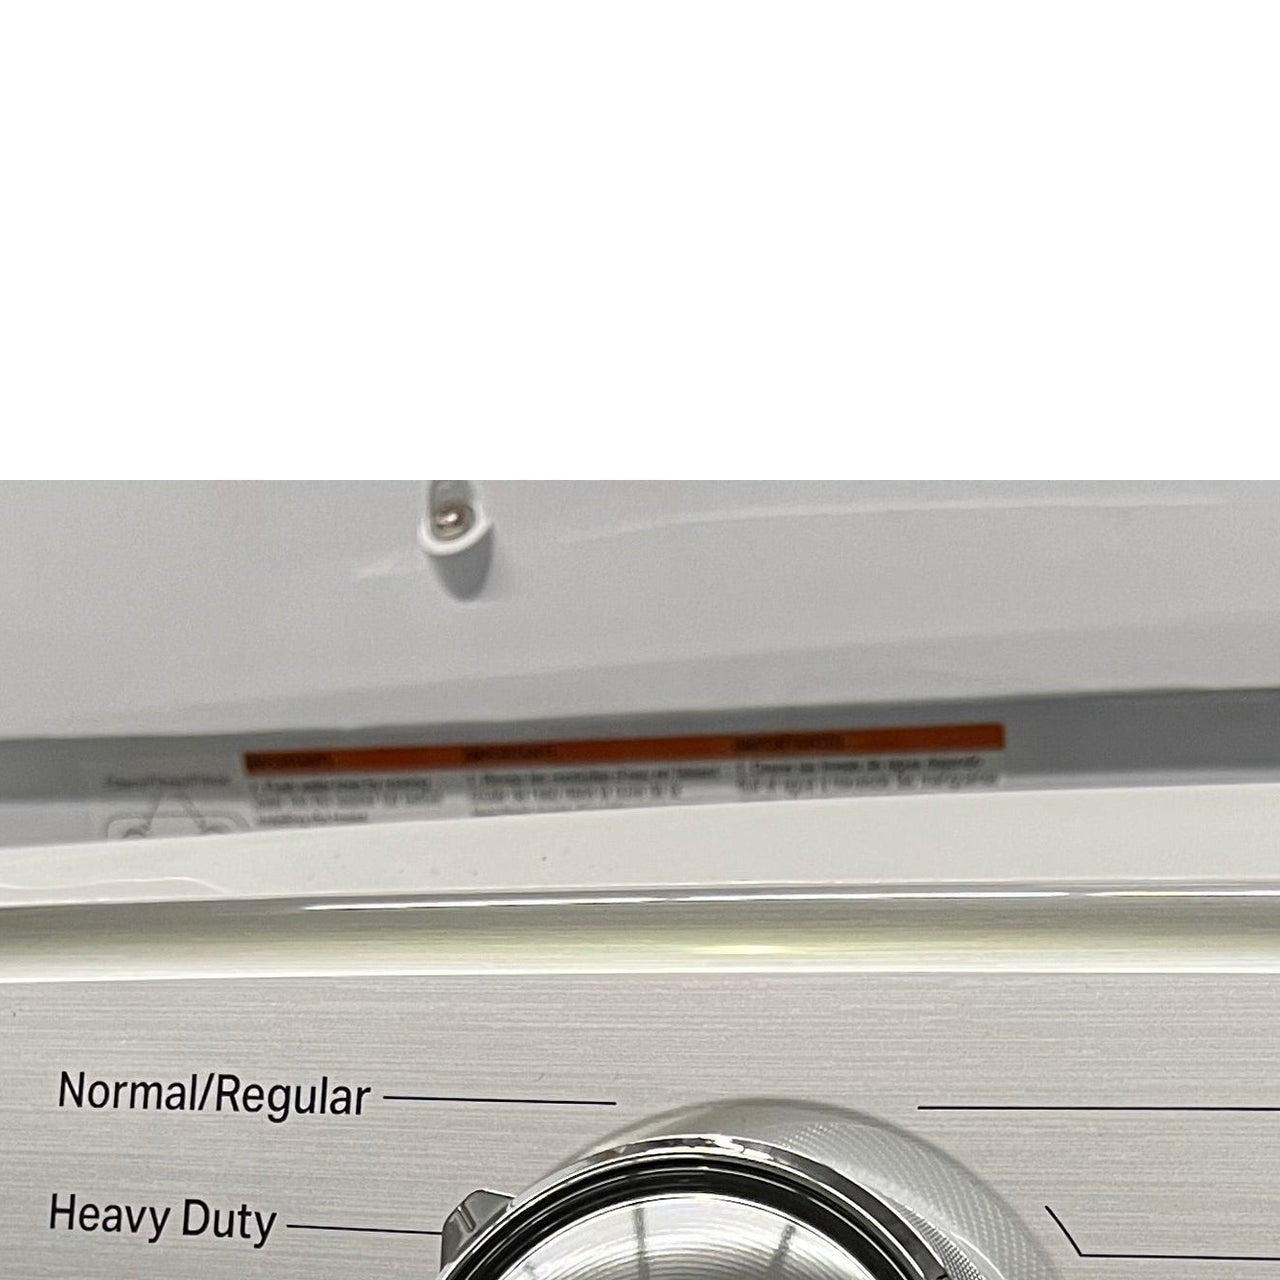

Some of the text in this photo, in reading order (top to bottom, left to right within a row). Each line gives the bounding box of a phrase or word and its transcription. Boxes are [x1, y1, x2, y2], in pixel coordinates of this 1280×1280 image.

[58, 1070, 372, 1123] Normal/Regular
[49, 1192, 278, 1249] Heavy Duty
